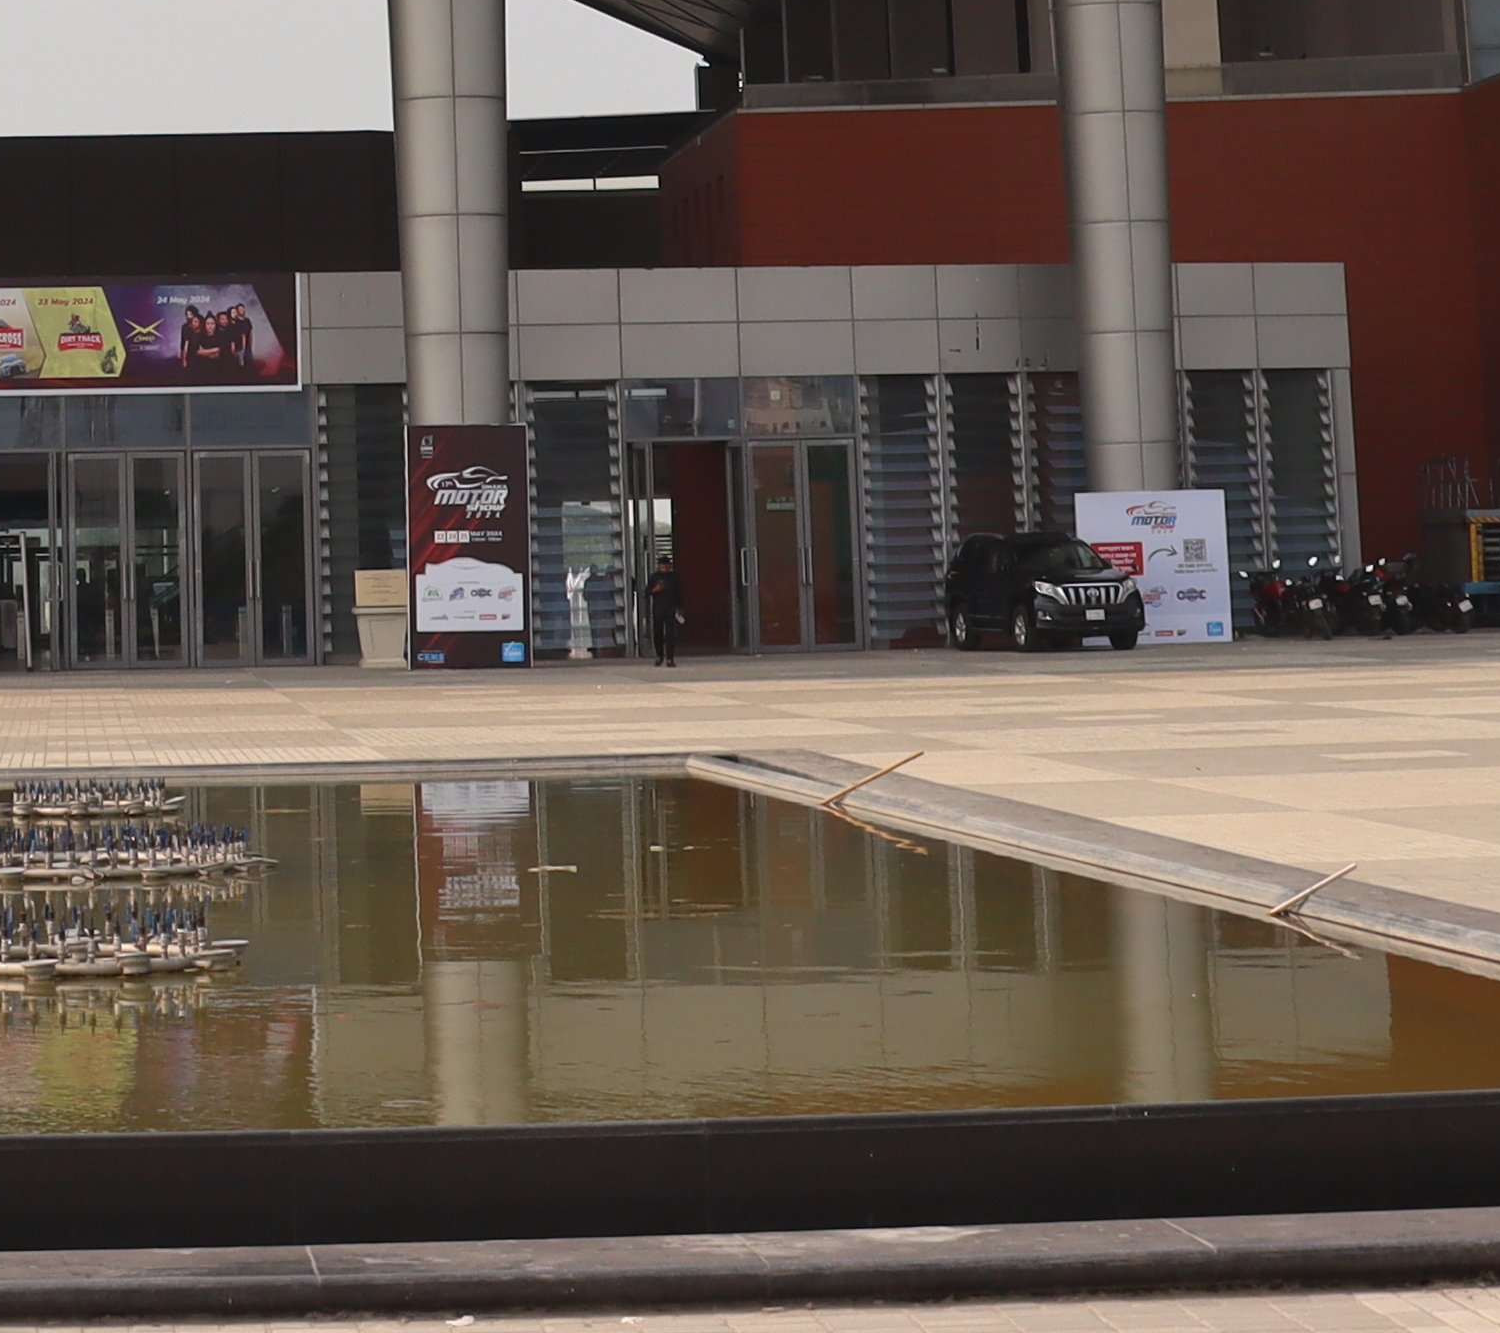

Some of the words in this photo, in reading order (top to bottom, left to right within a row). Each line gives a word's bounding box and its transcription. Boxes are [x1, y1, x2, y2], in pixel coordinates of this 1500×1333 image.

[51, 298, 69, 306] May
[169, 296, 188, 305] May
[434, 489, 508, 505] MOTOR
[1131, 516, 1177, 525] MOTOR
